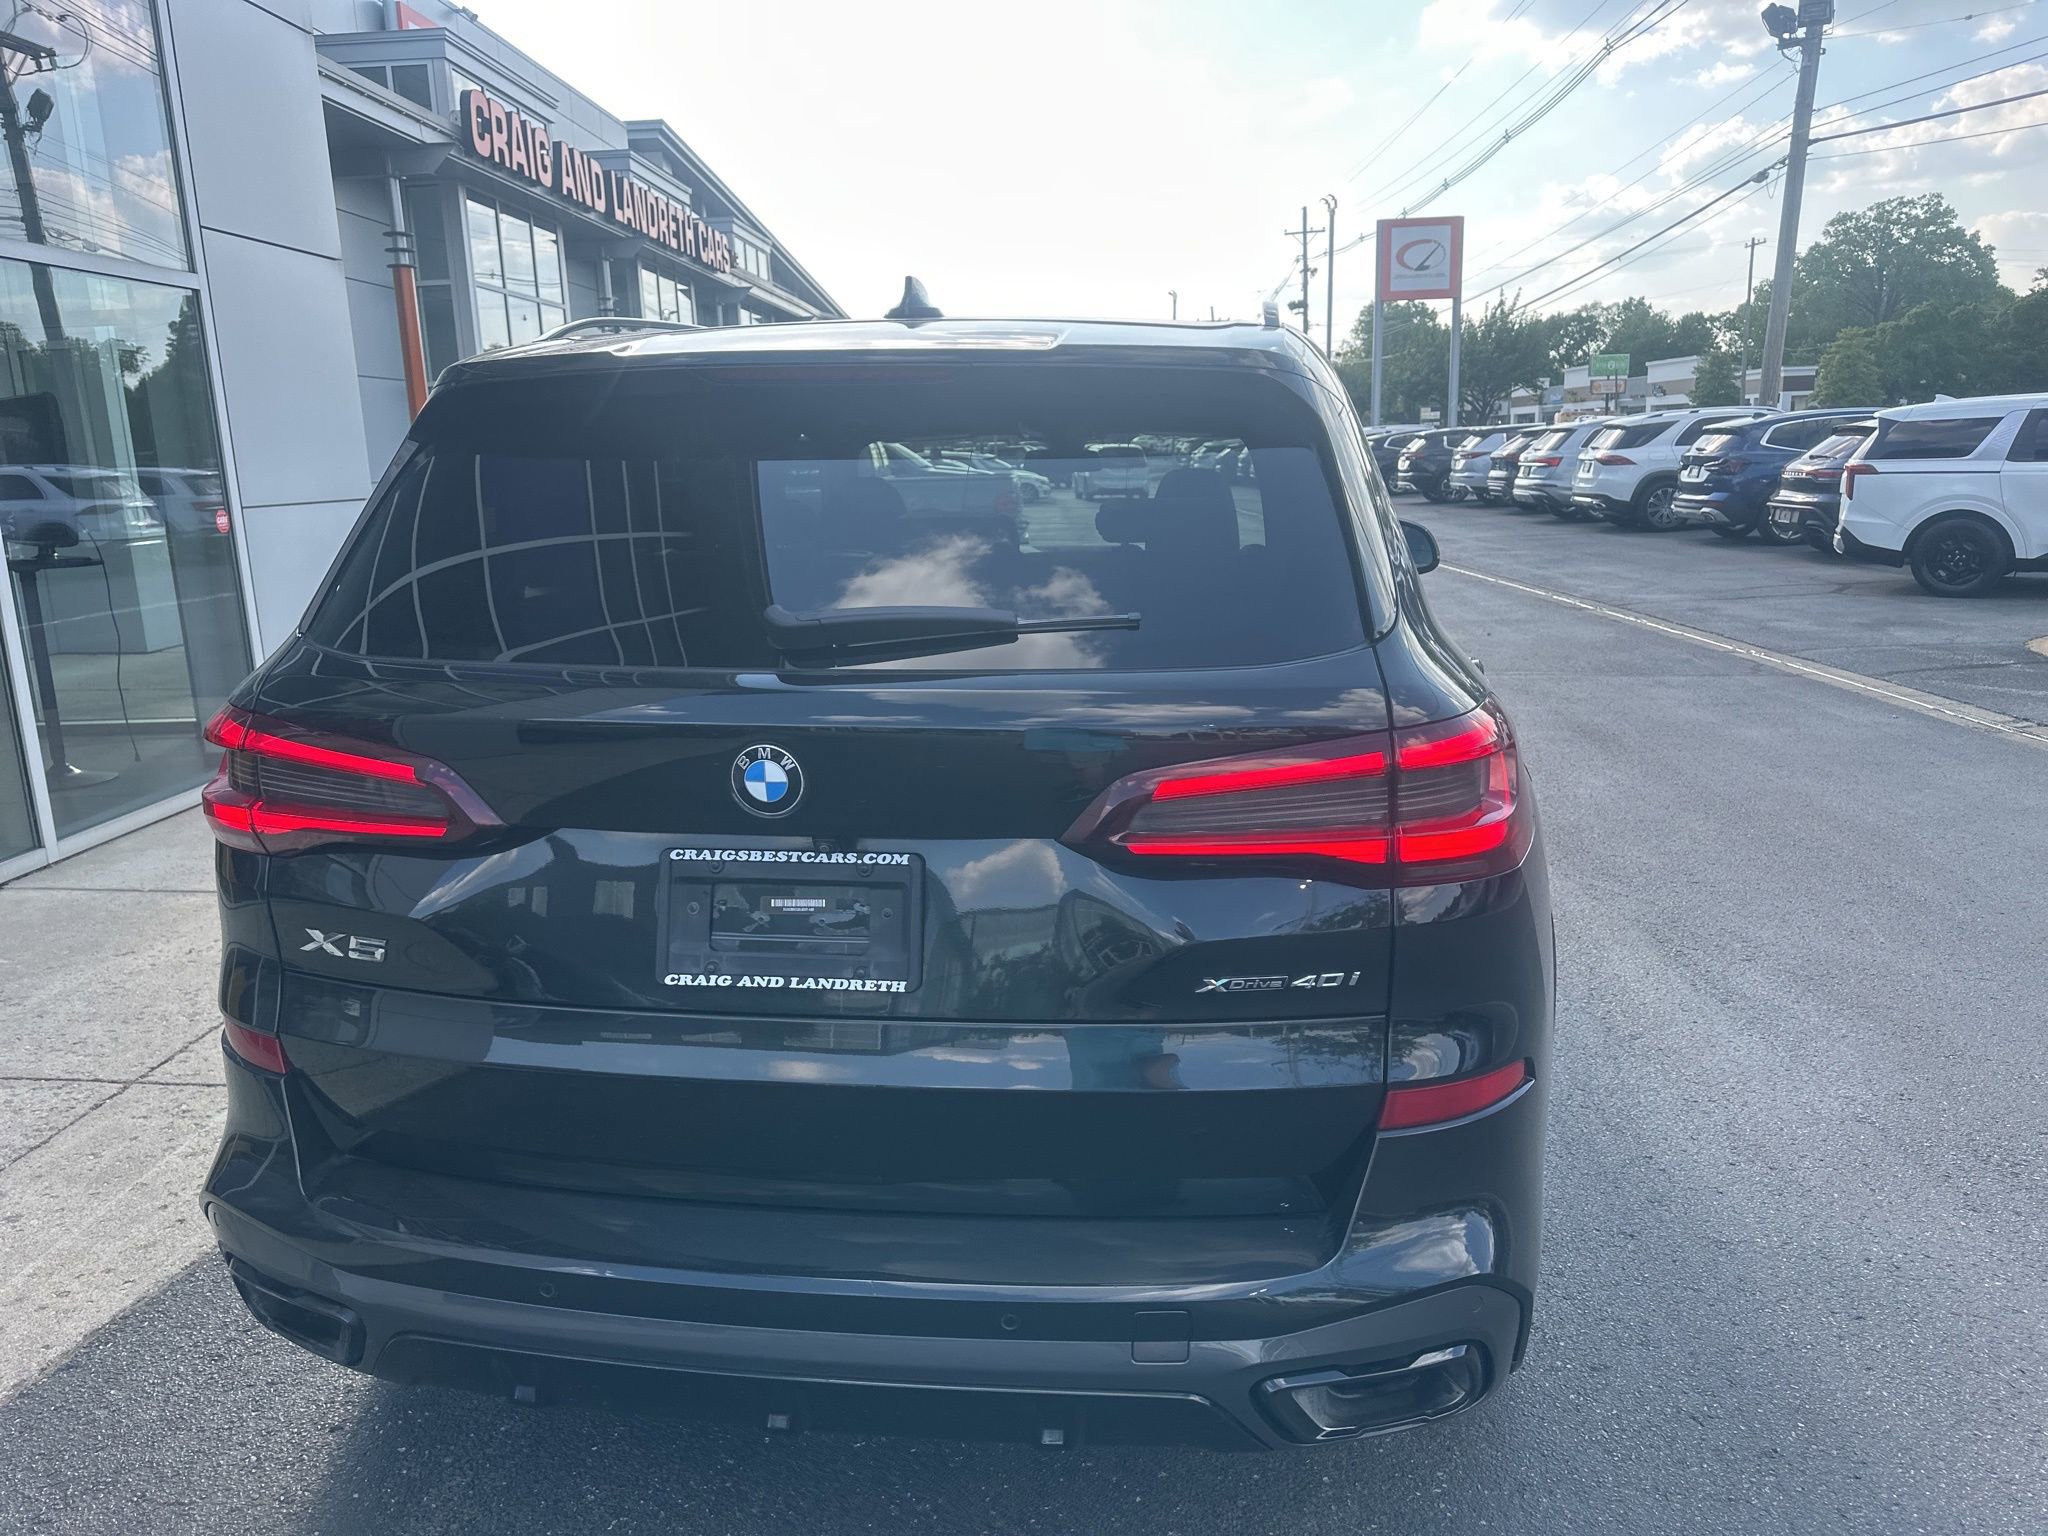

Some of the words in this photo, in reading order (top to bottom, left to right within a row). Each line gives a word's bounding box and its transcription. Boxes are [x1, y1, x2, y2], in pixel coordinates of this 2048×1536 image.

[469, 89, 552, 188] CRAIG
[561, 140, 606, 214] AND
[610, 170, 697, 258] LANDRETH
[698, 220, 731, 274] CARS
[737, 747, 796, 771] BMW
[669, 849, 911, 865] CRAIGSBESTCARS.COM
[299, 927, 387, 962] X5
[664, 974, 733, 987] CRAIG
[736, 976, 785, 989] AND
[789, 977, 908, 993] LANDRETH
